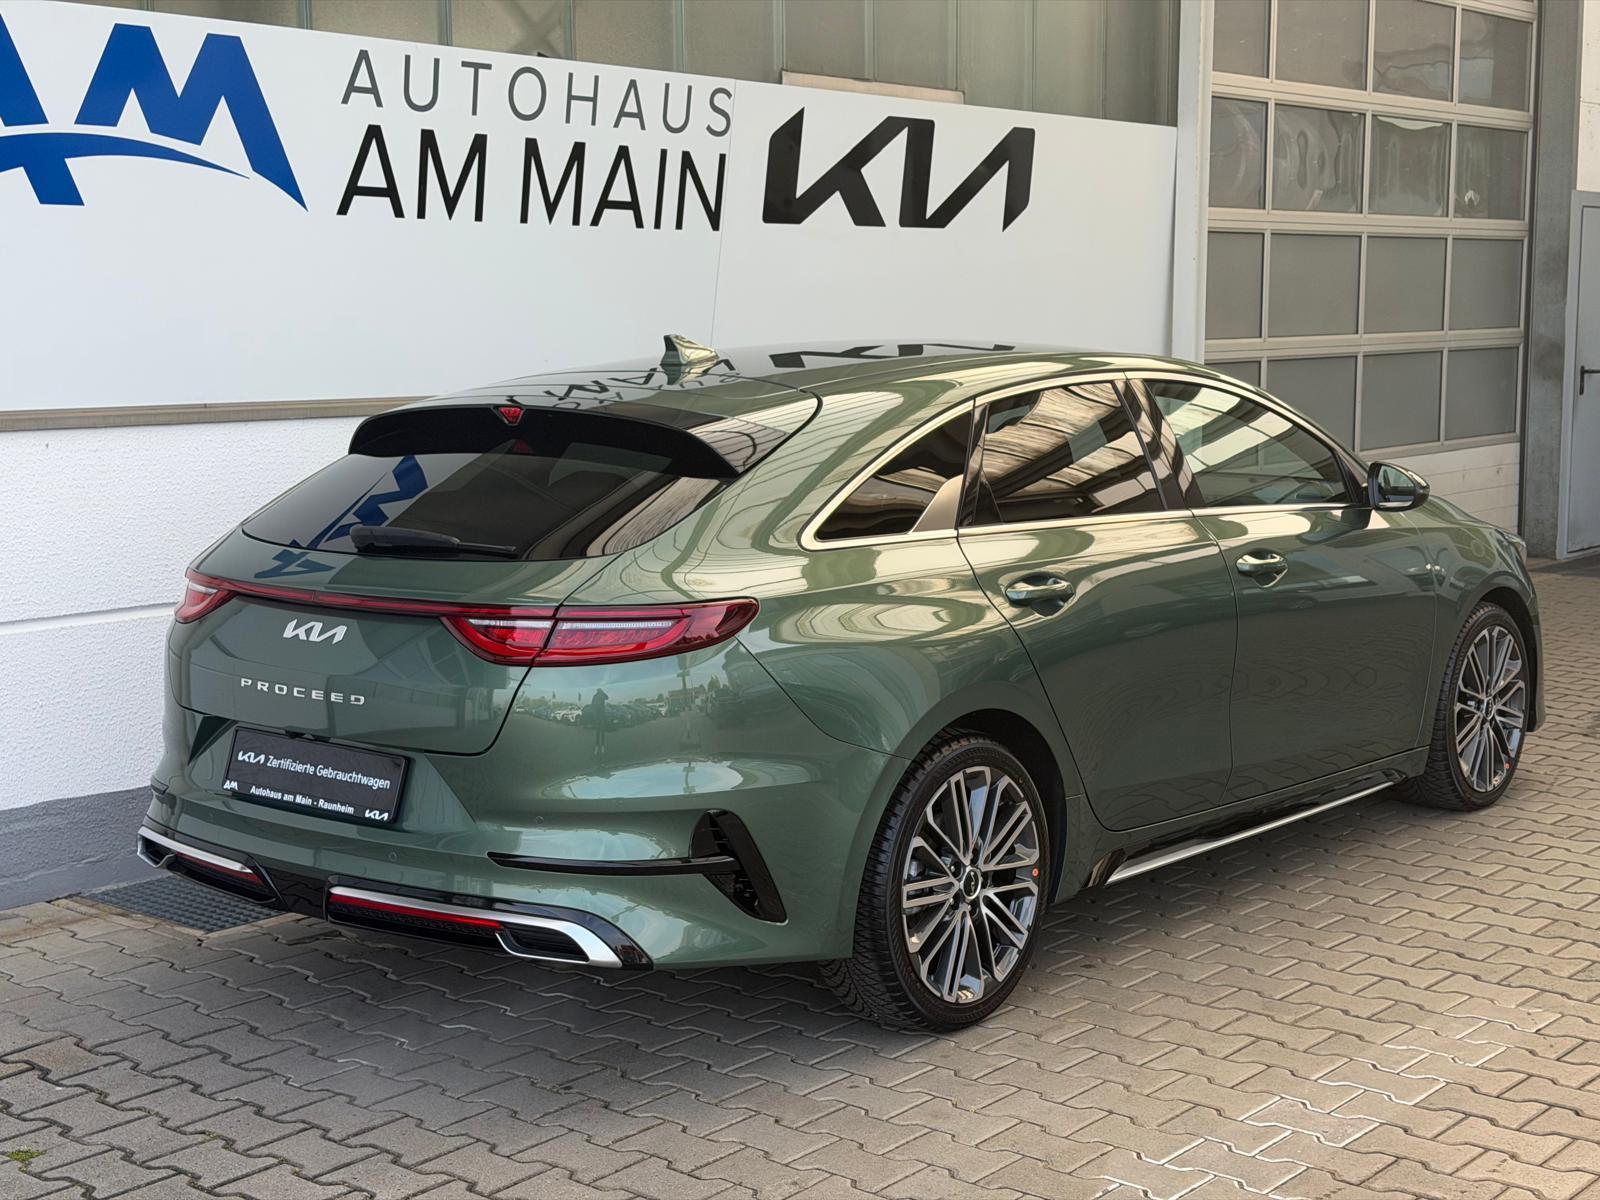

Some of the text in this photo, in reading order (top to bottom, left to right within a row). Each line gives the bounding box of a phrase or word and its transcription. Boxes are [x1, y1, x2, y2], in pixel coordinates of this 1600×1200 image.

[340, 49, 733, 137] AUTOHAUS
[336, 124, 727, 232] AM MAIN
[761, 106, 1036, 233] KIA
[282, 618, 348, 645] KIA
[240, 677, 365, 705] PROCEED
[237, 750, 391, 790] KIA Zertifizierte Gebrauchtwagen
[250, 785, 282, 800] Autohaus
[283, 793, 294, 803] am
[295, 794, 312, 806] Main
[318, 798, 355, 815] Raunheim
[364, 809, 389, 821] KIA
